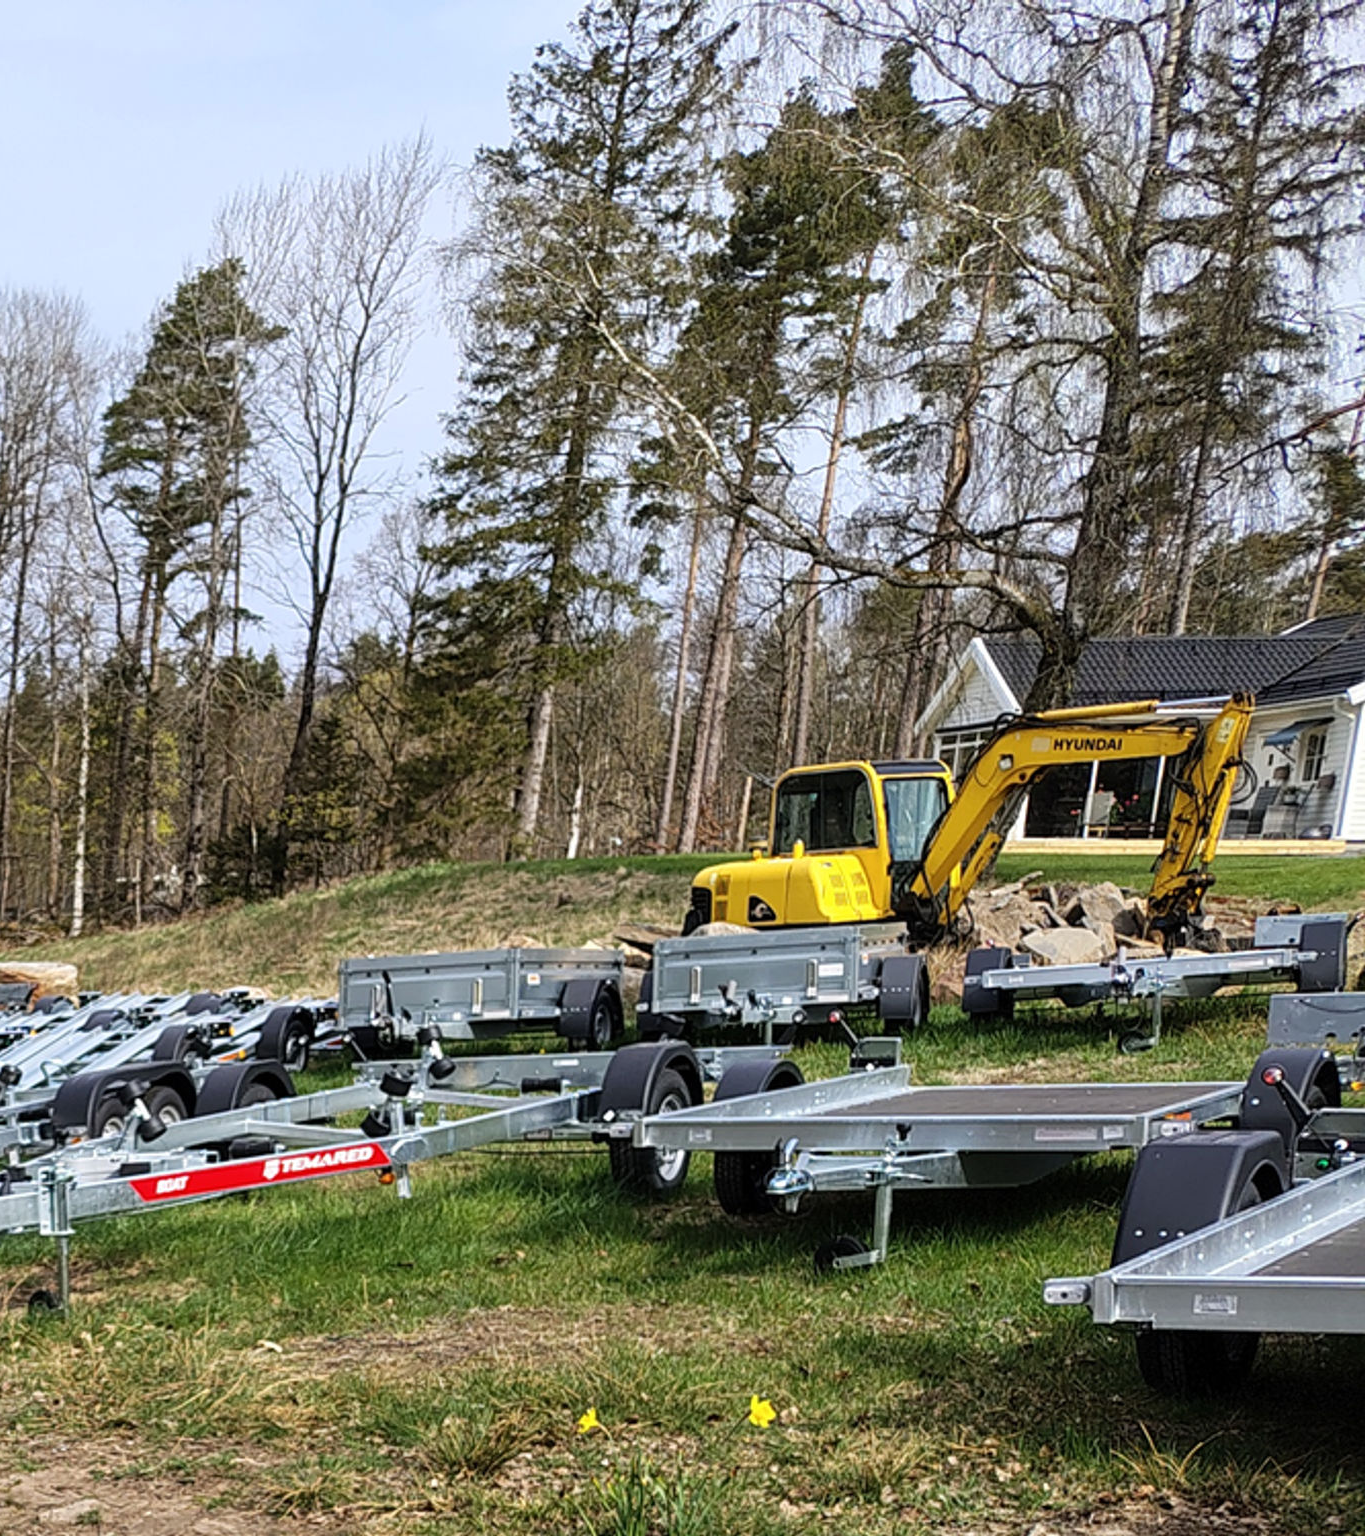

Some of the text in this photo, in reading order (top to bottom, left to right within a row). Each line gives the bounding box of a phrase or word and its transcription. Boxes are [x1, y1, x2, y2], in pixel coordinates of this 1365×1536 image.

[1053, 738, 1123, 751] HYUNDAI
[156, 1146, 374, 1194] BOAT TEMARED
